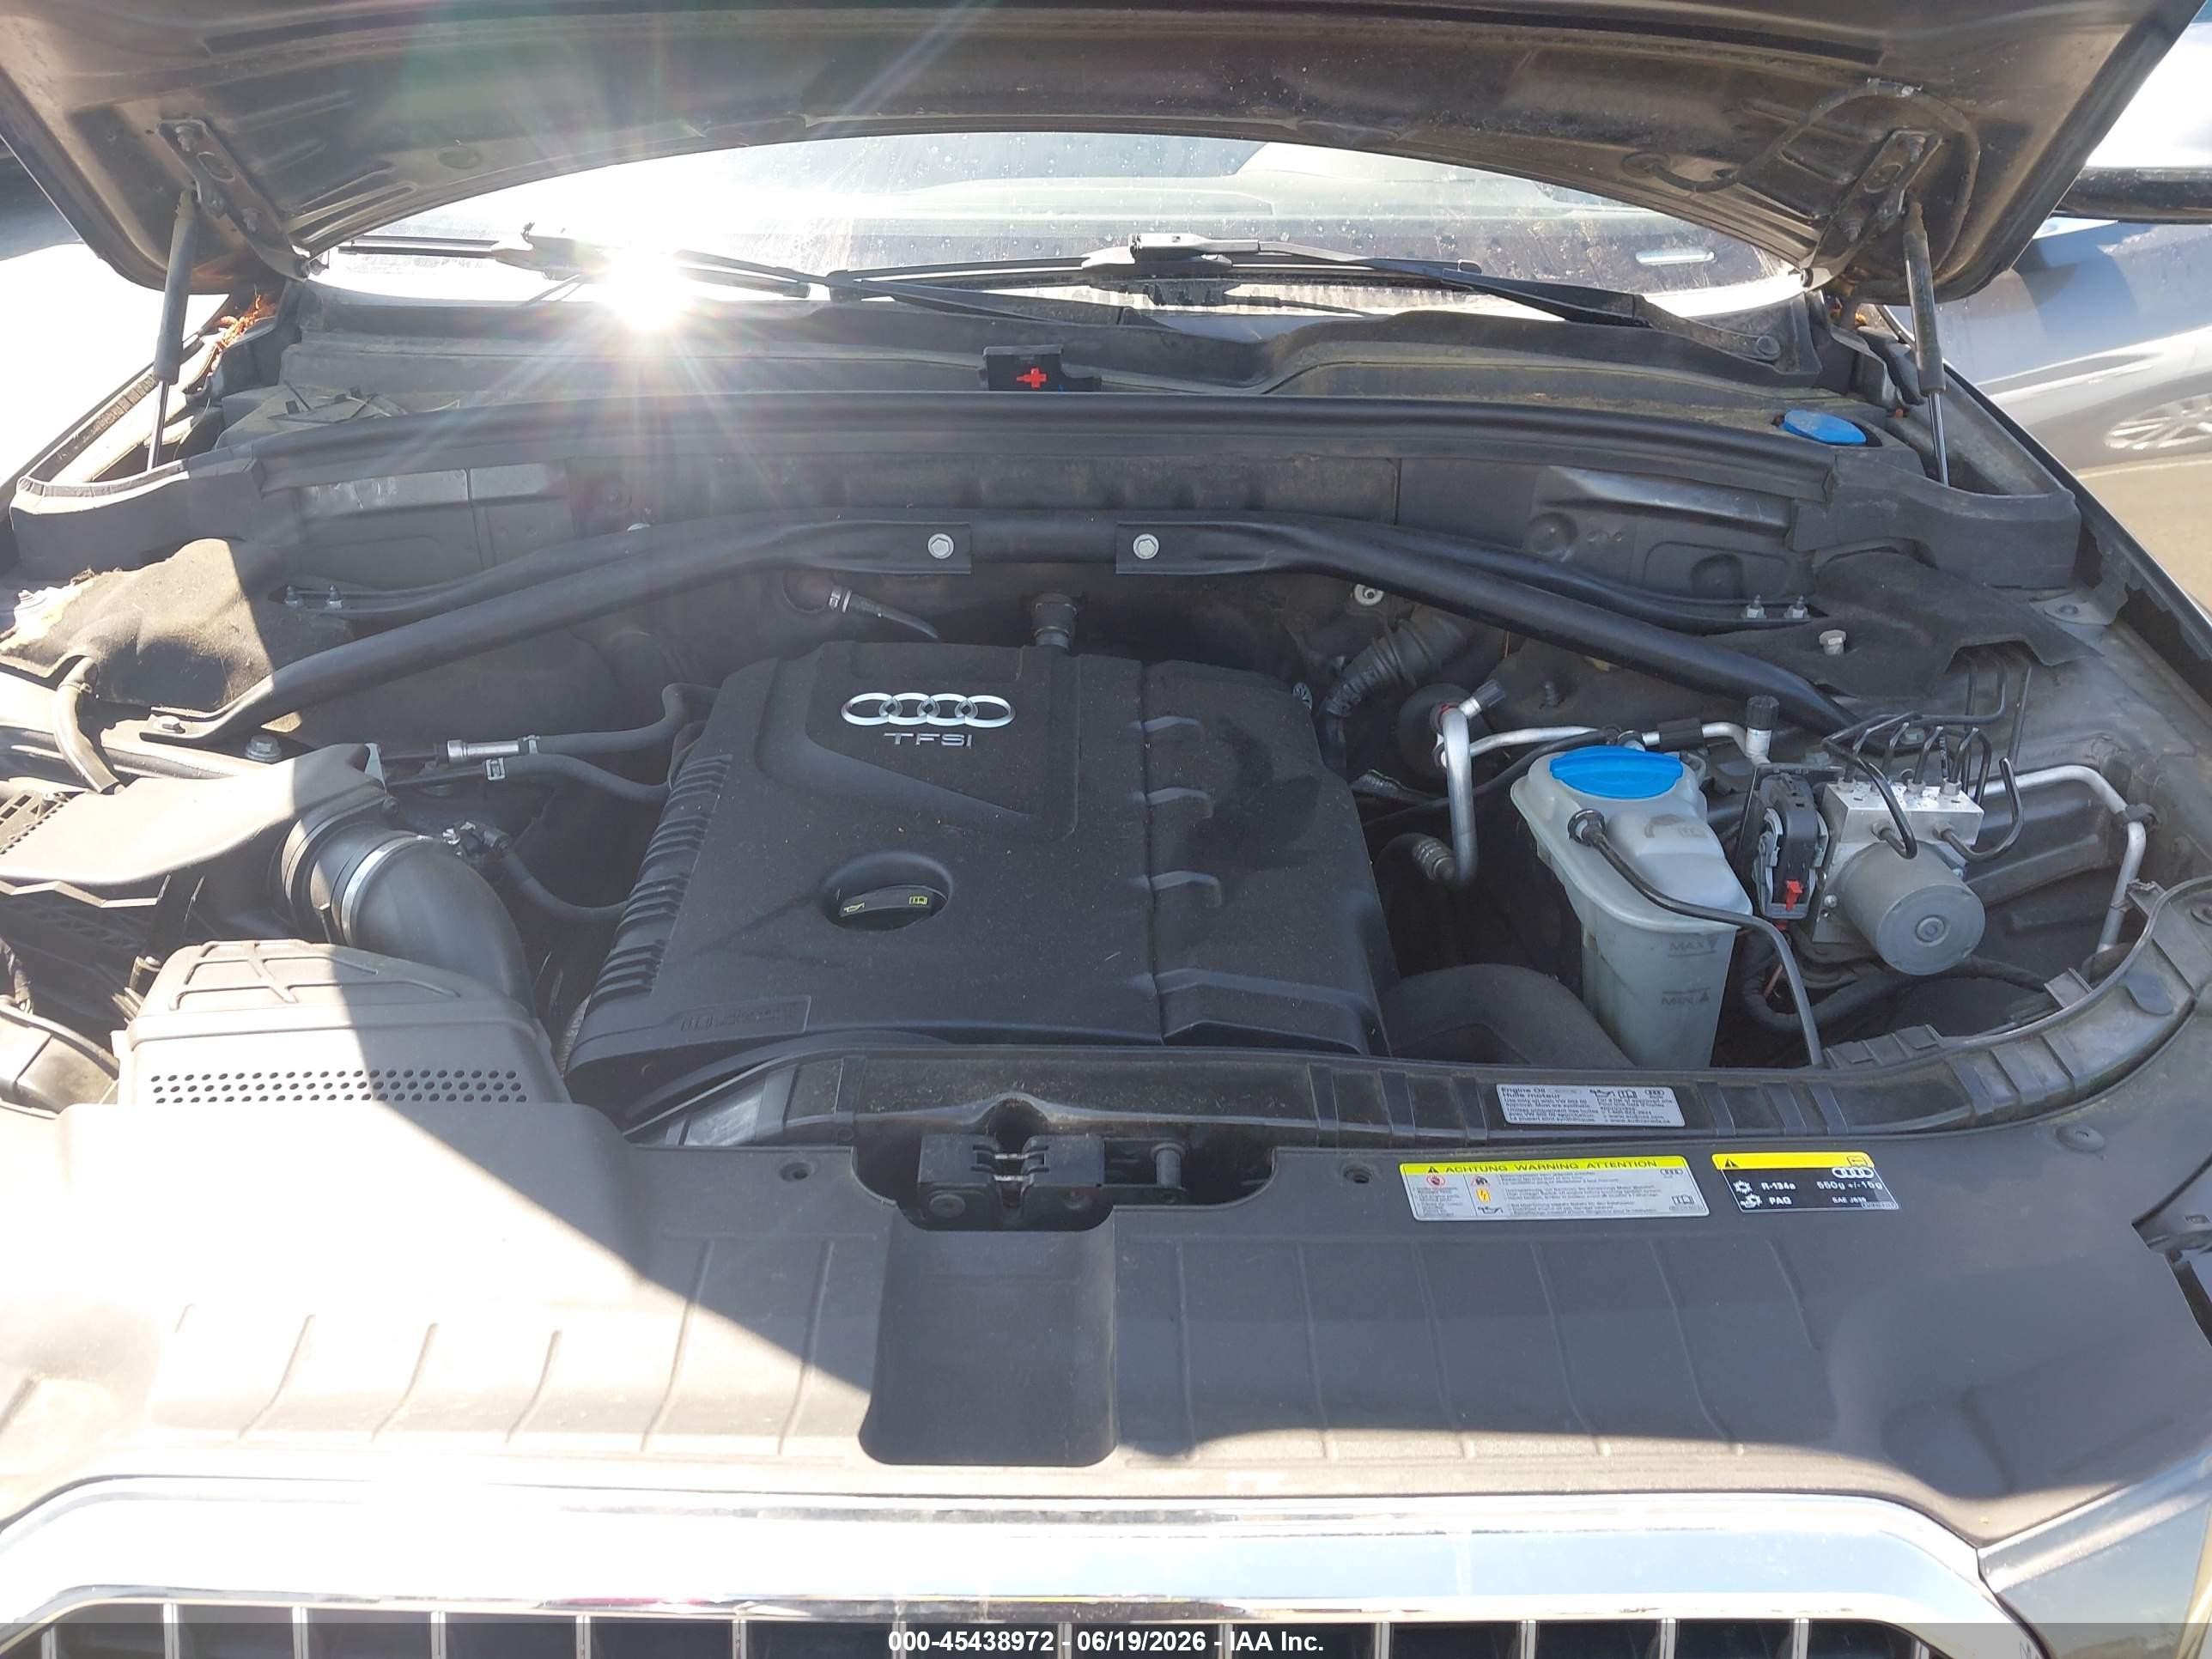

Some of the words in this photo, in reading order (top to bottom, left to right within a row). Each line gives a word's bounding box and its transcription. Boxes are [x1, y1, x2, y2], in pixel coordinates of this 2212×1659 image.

[884, 732, 972, 749] TFSI
[1668, 940, 1705, 951] MAX
[1445, 1165, 1509, 1174] ACHTUNG
[1514, 1163, 1580, 1171] WARNING
[1586, 1159, 1658, 1169] ATTENTION
[1761, 1182, 1796, 1190] R-134a
